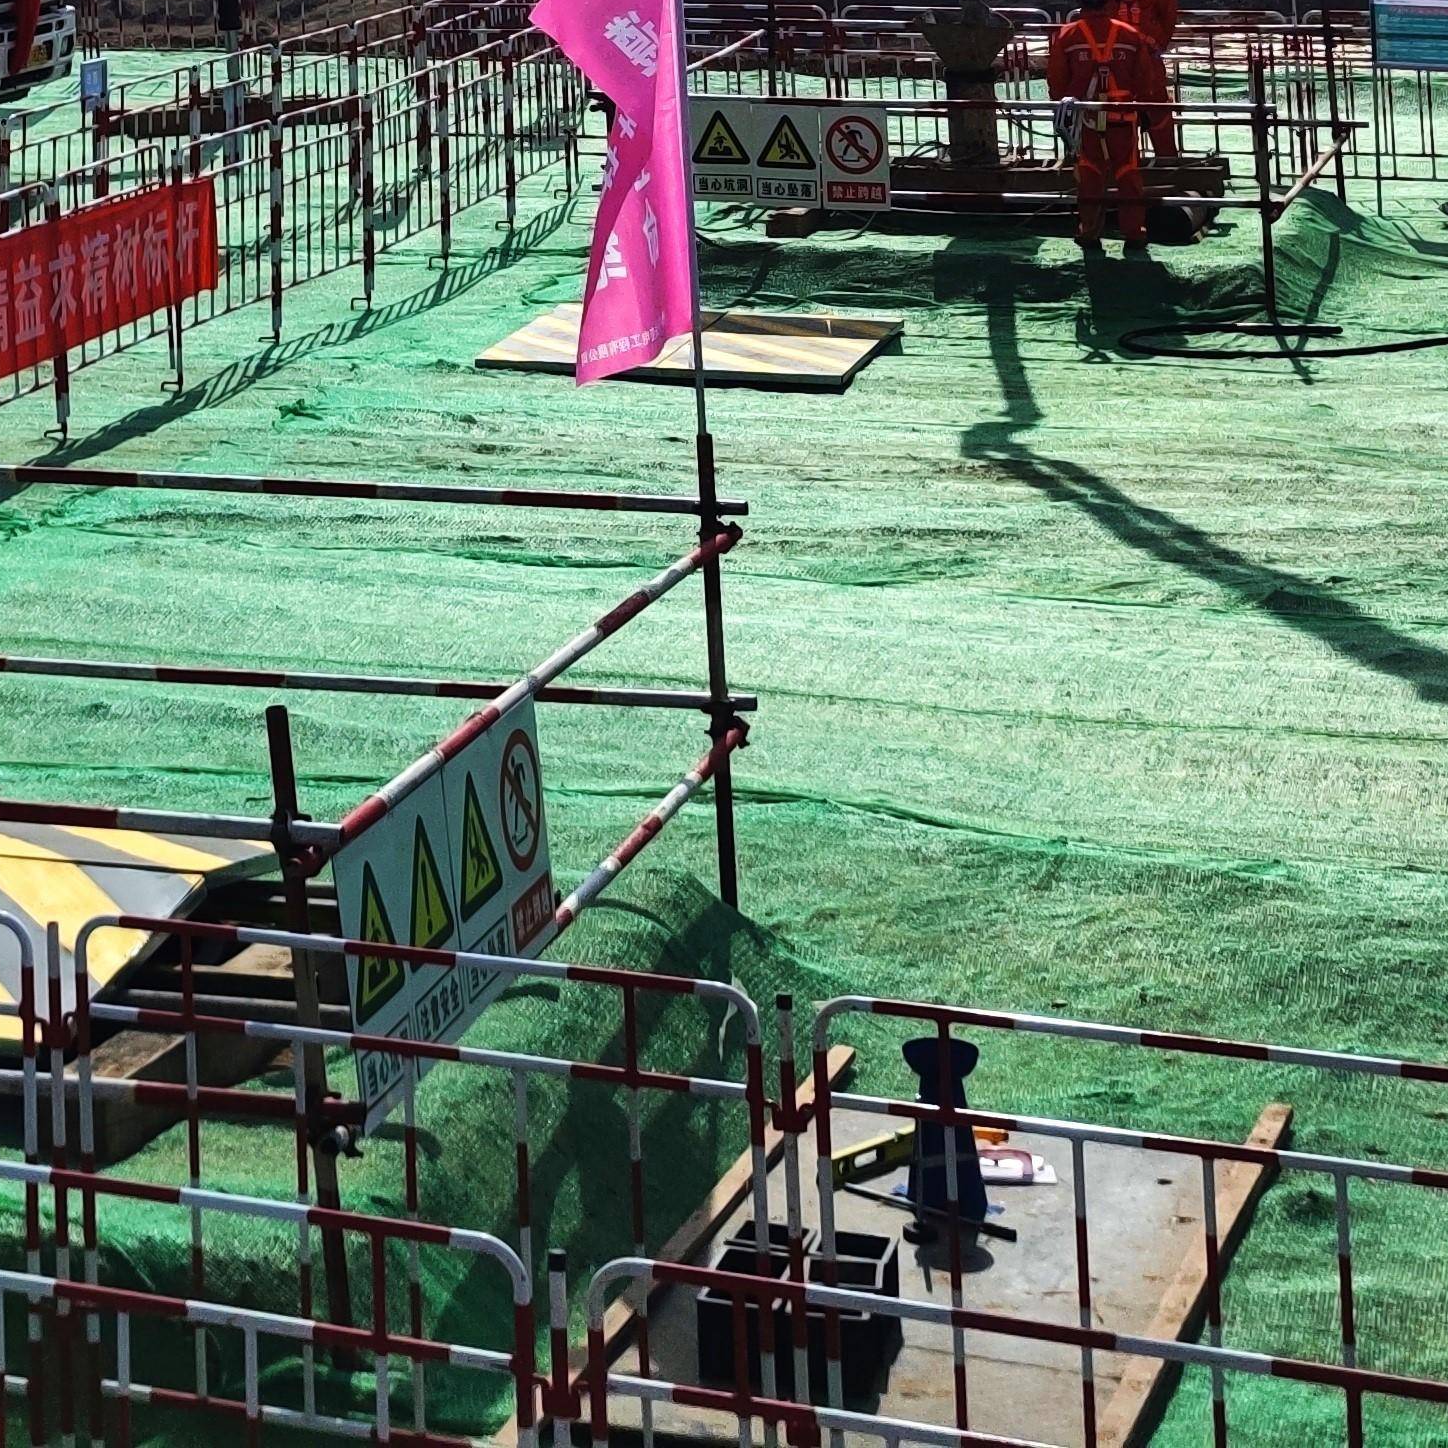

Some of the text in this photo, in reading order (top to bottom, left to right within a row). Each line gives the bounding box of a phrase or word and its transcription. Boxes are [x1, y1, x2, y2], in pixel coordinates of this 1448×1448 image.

[698, 176, 749, 193] 当心坑洞
[761, 181, 813, 200] 当心坠落
[832, 185, 883, 201] 禁止跨越
[417, 976, 460, 1038] 注意安全
